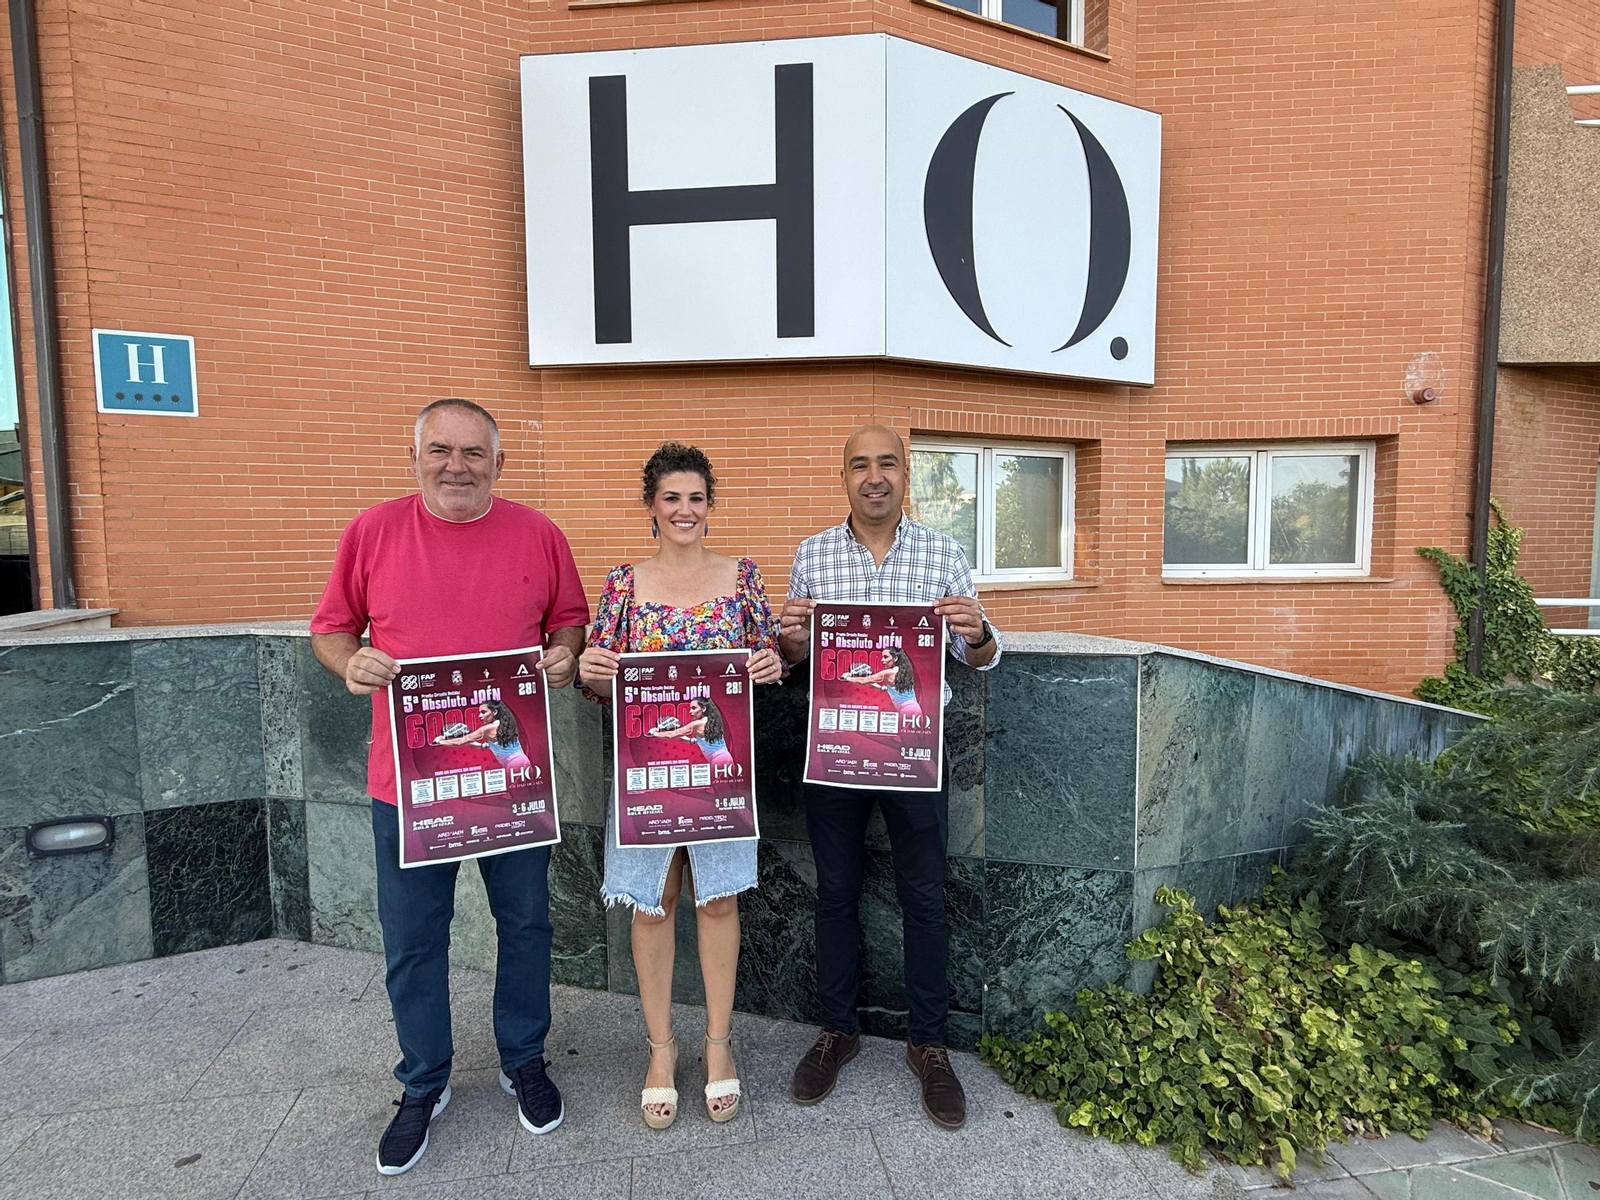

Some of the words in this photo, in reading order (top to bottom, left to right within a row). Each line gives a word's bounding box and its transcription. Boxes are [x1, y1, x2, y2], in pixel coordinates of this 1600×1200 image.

[123, 342, 169, 385] H
[836, 636, 873, 649] Absoluto
[641, 689, 680, 703] Absoluto
[422, 695, 467, 711] Absoluto
[914, 748, 931, 758] JULIO
[527, 800, 545, 811] JULIO
[729, 797, 745, 806] JULIO
[413, 816, 454, 828] HEAD
